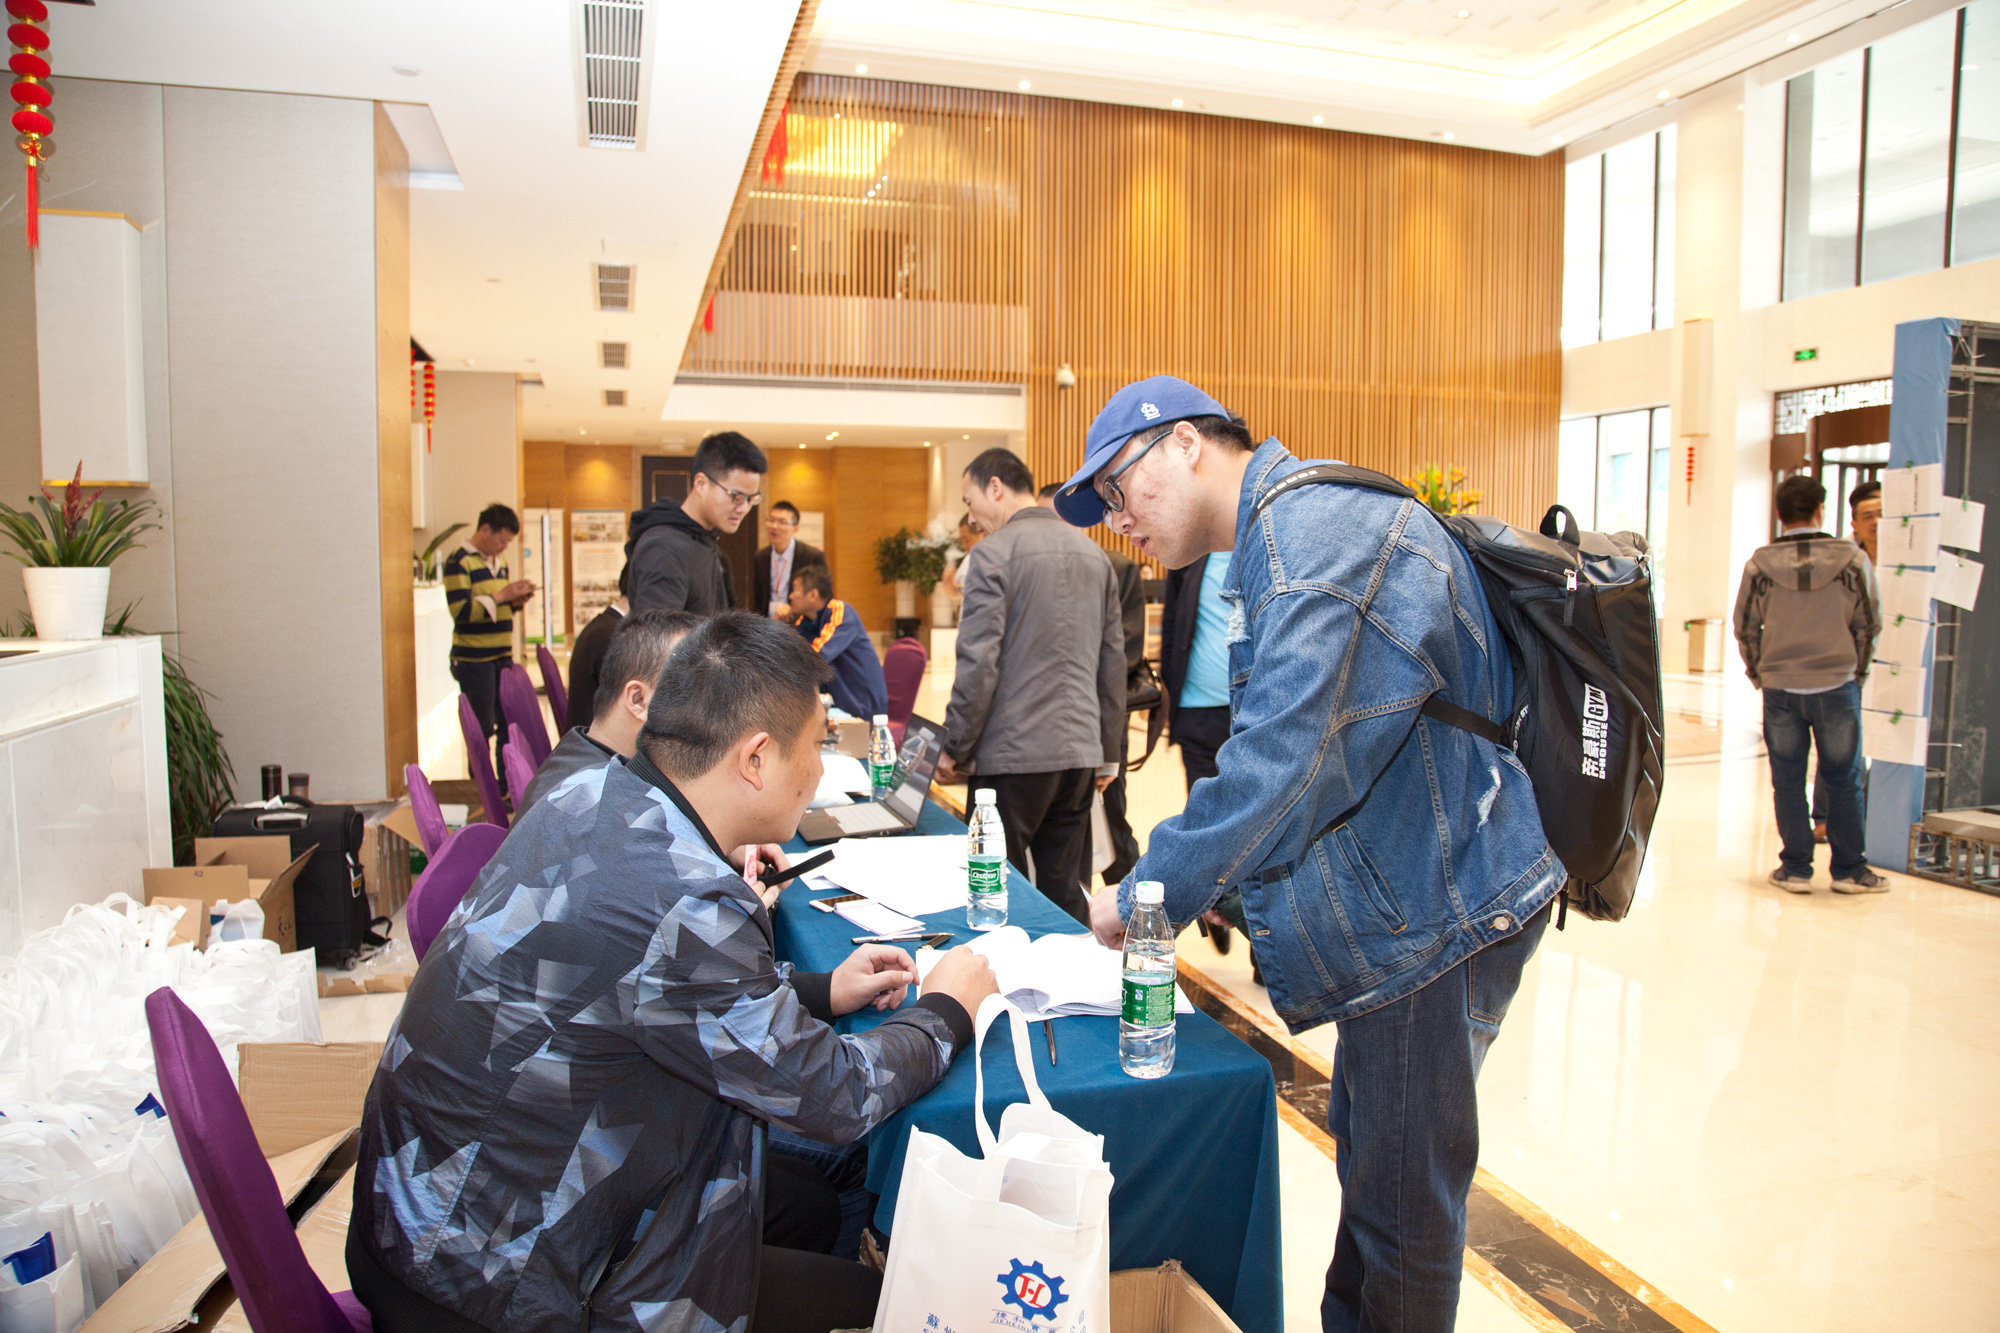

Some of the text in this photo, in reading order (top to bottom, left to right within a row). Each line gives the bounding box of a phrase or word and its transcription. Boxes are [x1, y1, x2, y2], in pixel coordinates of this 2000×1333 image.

[1587, 686, 1605, 717] GYM
[1582, 719, 1601, 777] 帝豪斯
